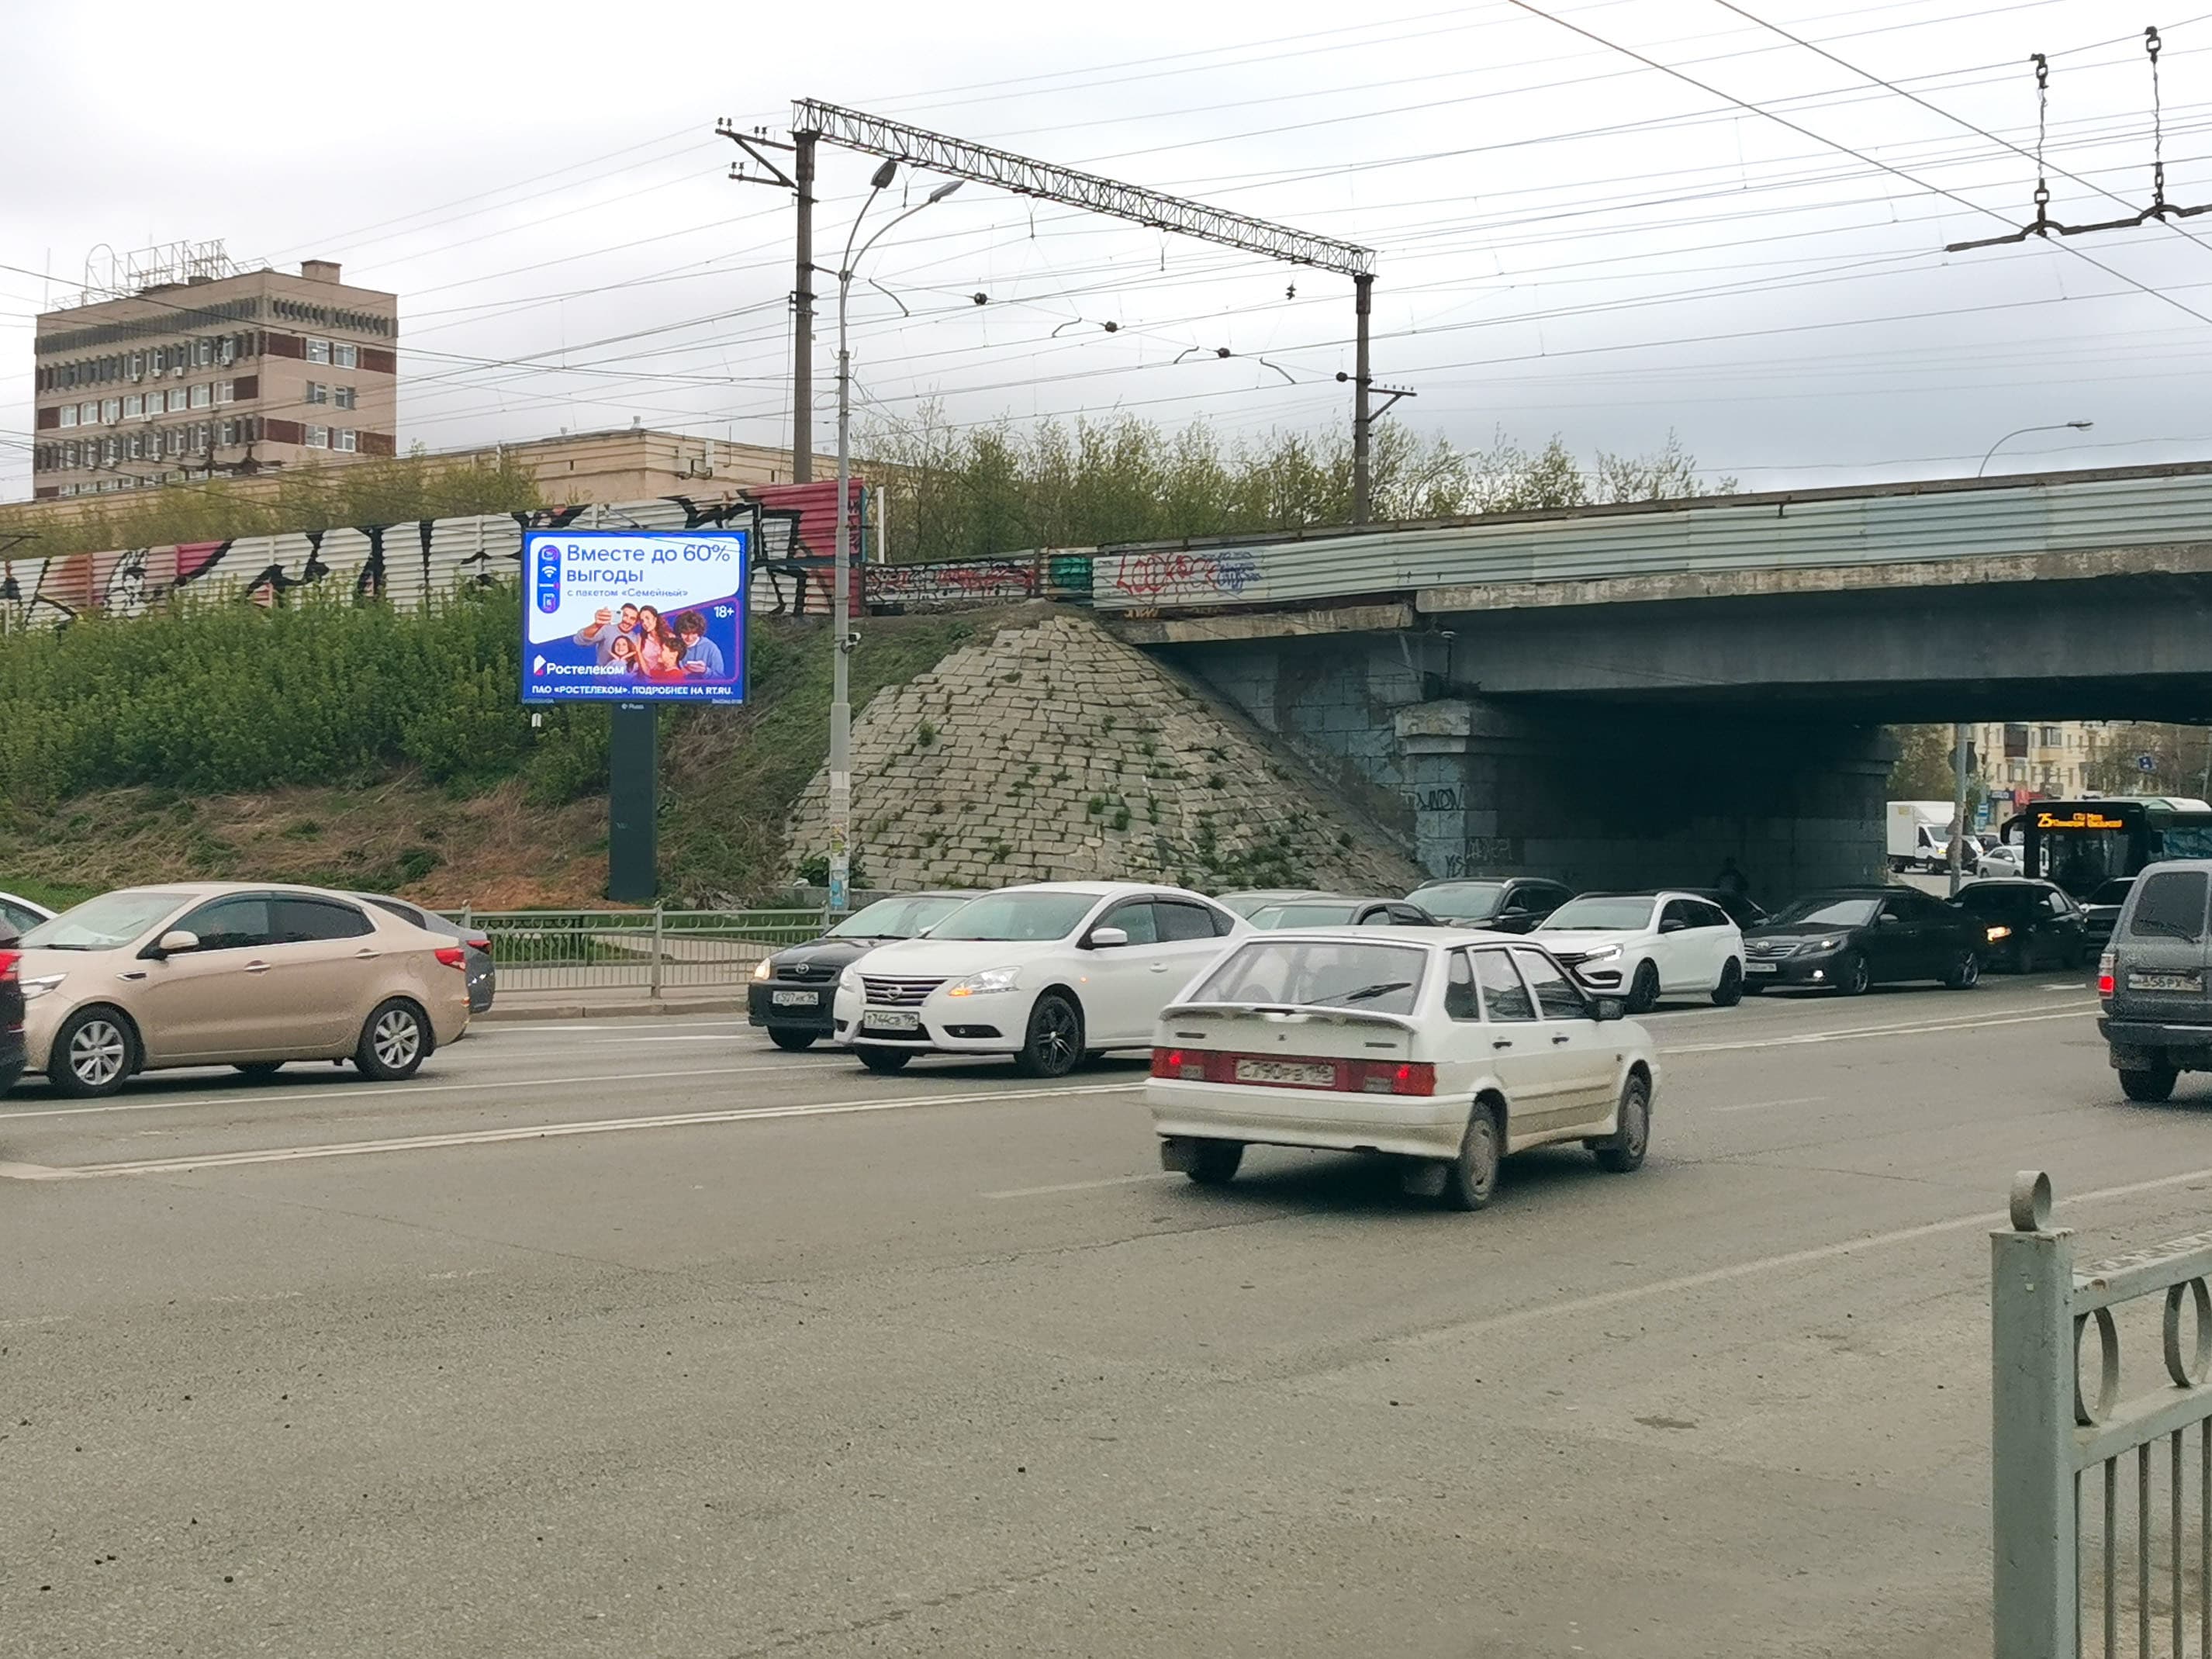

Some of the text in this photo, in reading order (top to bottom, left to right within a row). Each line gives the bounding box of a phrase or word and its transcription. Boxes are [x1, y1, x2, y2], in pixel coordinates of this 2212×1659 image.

[567, 544, 731, 564] Вместе до 60%
[567, 569, 644, 585] выгоды
[621, 587, 689, 597] «Семейный»
[713, 605, 735, 619] 18+
[546, 662, 624, 676] Ростелеком
[532, 686, 552, 694] ПАО
[632, 686, 689, 696] ПОДРОБНЕЕ
[690, 686, 703, 696] НА
